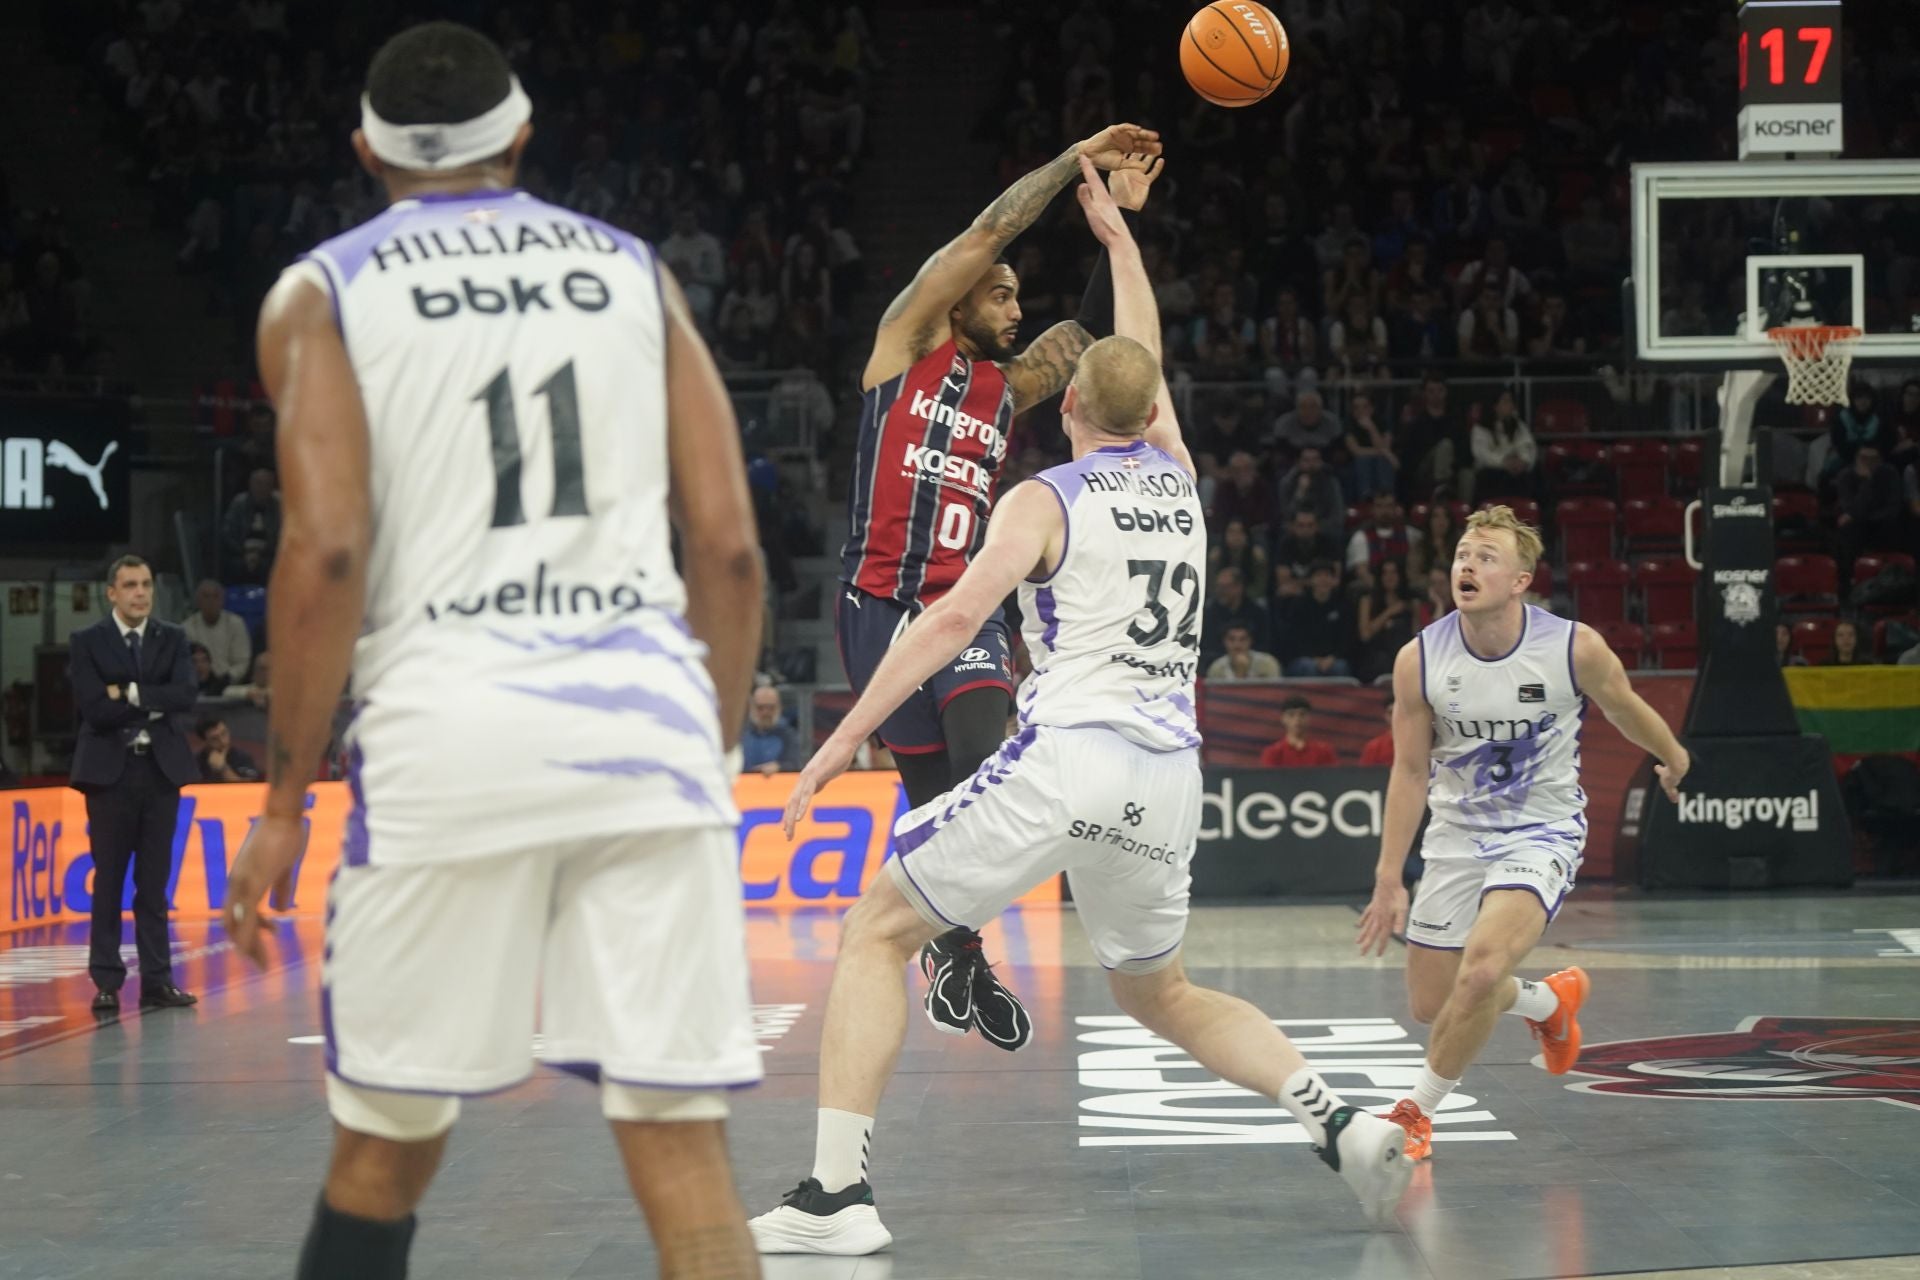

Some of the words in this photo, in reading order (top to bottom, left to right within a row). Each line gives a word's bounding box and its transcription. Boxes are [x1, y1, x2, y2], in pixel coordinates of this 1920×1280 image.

[1759, 27, 1833, 85] 17
[1755, 119, 1836, 136] kosner
[372, 221, 619, 271] HILLIARD
[411, 277, 553, 319] bbk
[470, 357, 593, 530] 11
[937, 502, 971, 551] 0
[1110, 507, 1174, 533] bbk
[1126, 559, 1200, 652] 32
[954, 662, 997, 673] HYUNDAI
[1490, 746, 1515, 783] 3
[1068, 820, 1103, 842] SR
[1678, 789, 1819, 831] kingroyal
